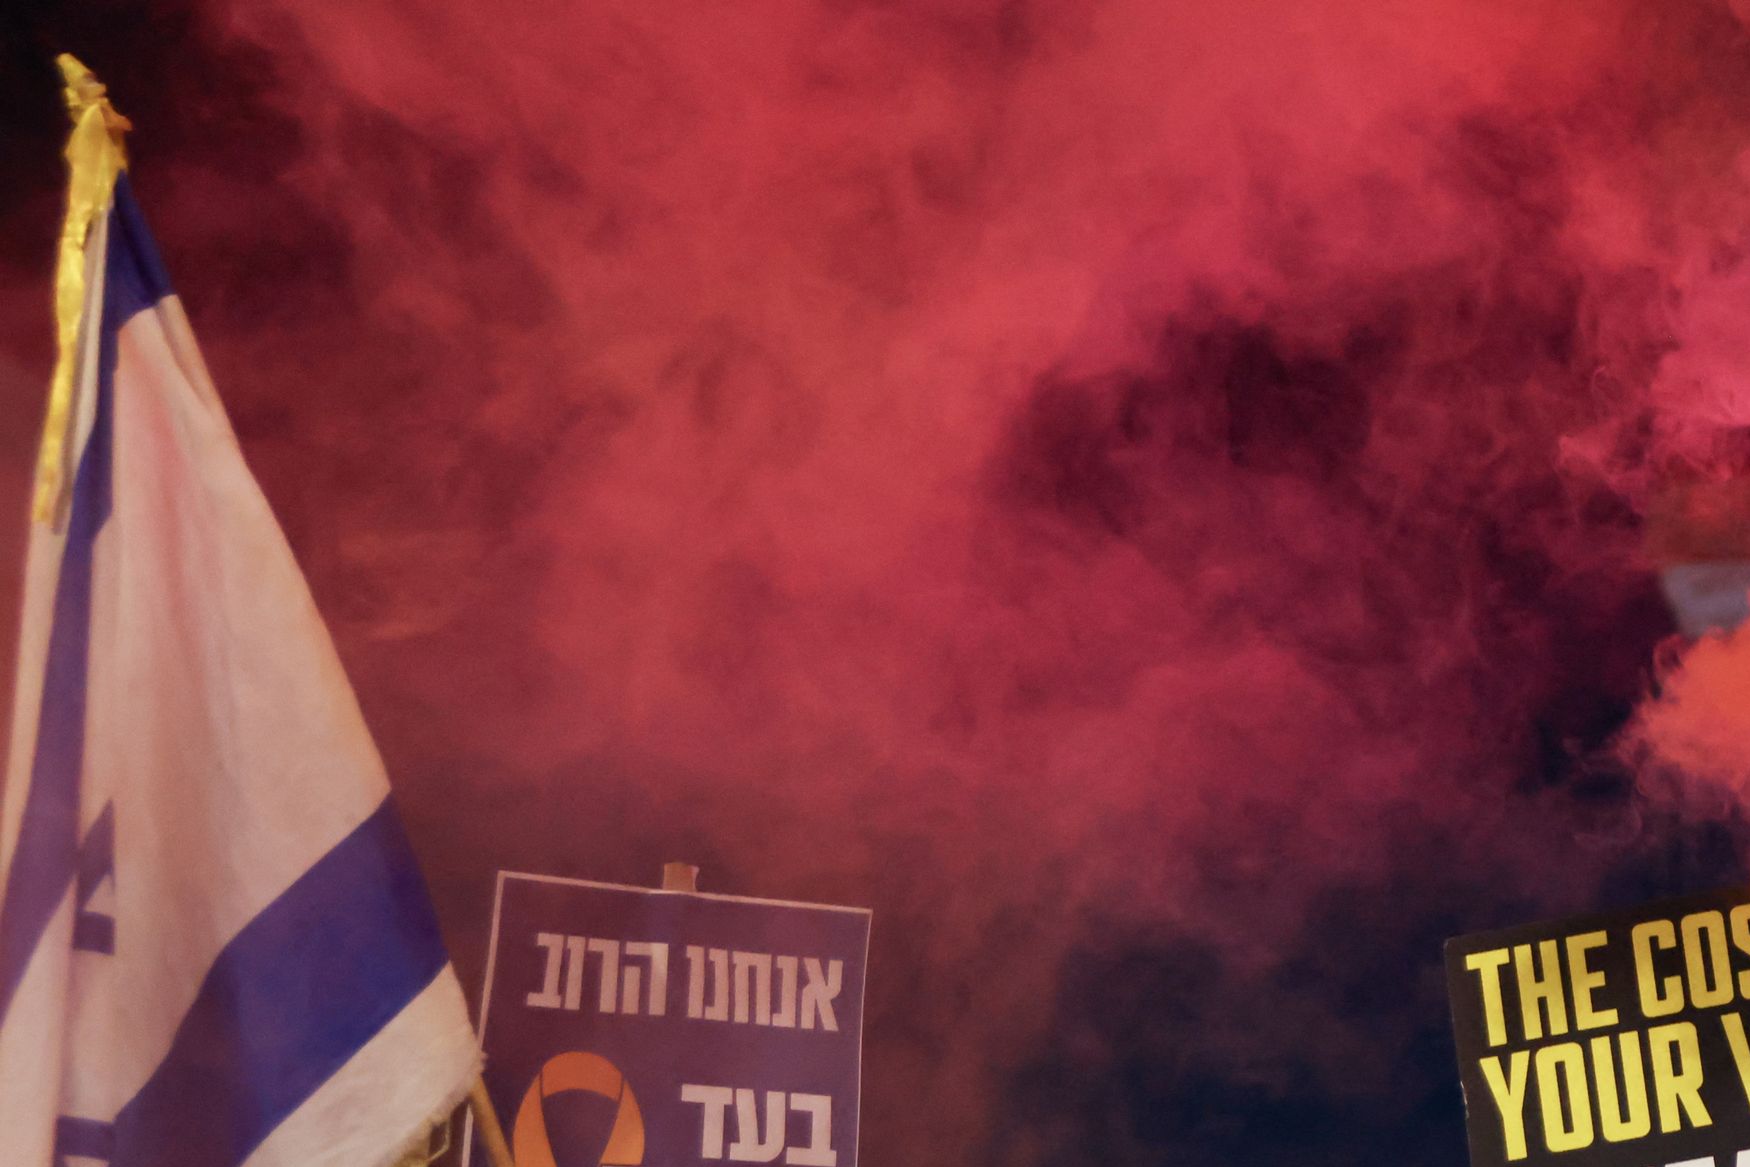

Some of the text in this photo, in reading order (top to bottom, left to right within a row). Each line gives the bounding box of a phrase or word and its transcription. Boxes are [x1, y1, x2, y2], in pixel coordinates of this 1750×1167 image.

[526, 932, 843, 1031] אנחנו הרוב
[1465, 930, 1617, 1047] THE
[682, 1083, 837, 1167] בעד
[1480, 1021, 1704, 1161] YOUR
